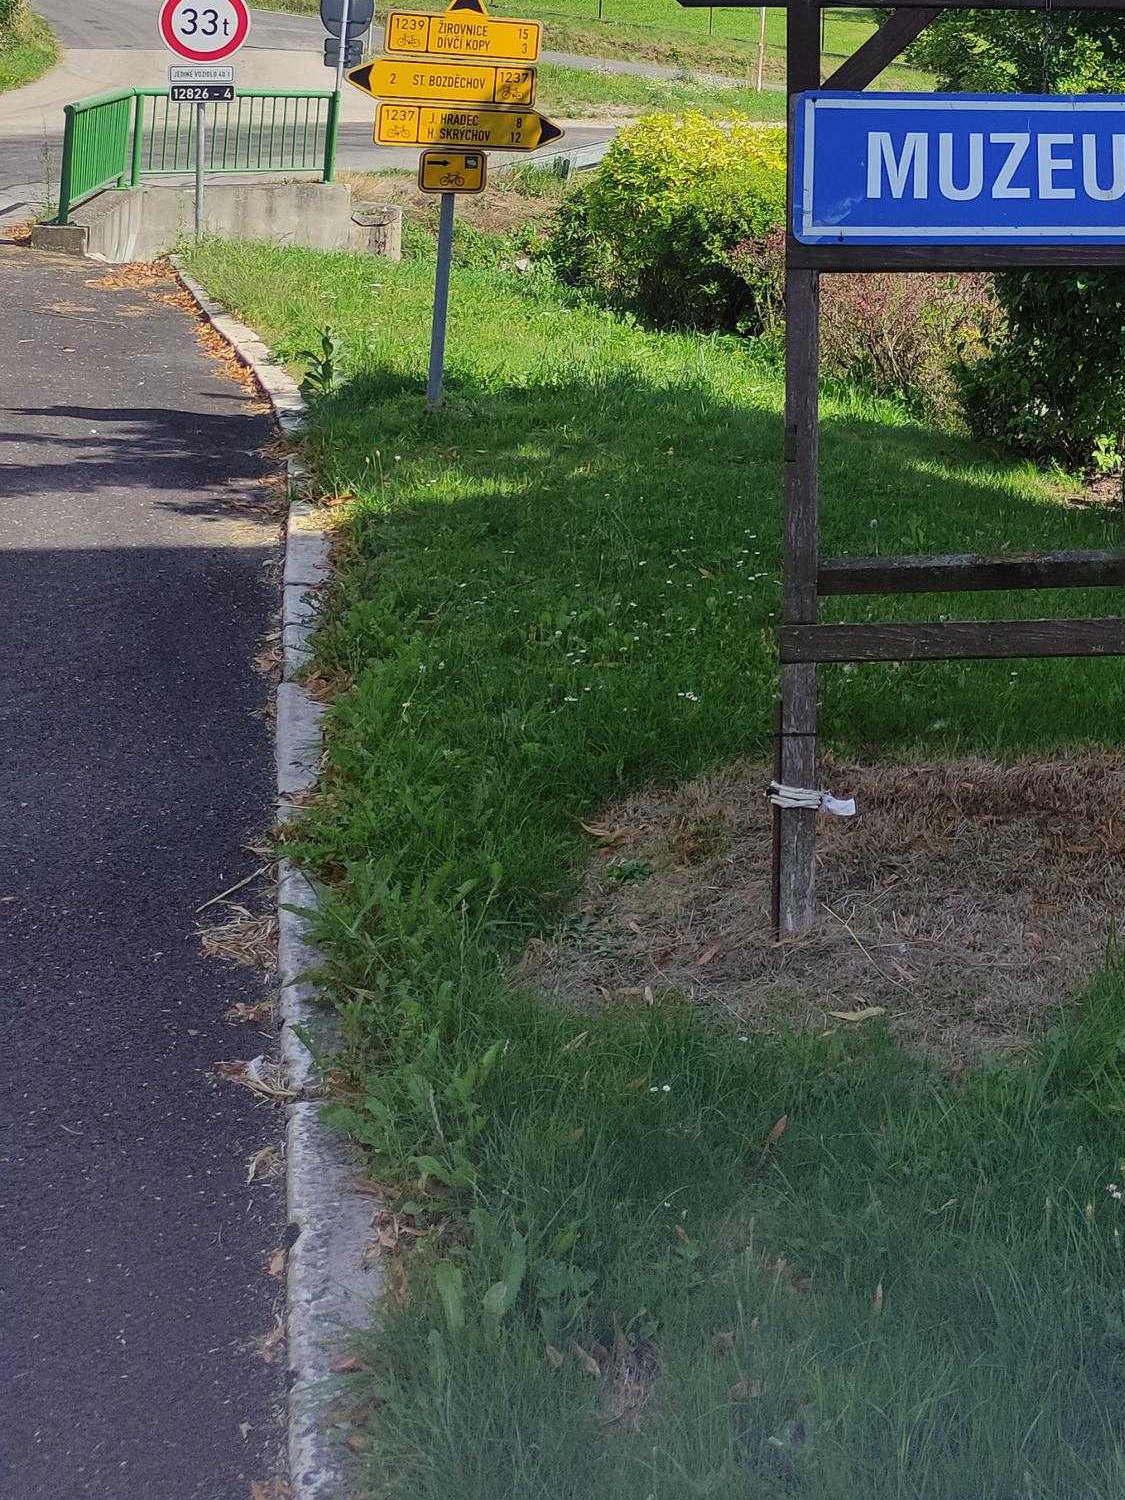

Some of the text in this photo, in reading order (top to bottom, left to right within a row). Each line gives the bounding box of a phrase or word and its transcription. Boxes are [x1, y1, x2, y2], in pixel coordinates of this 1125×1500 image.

[395, 18, 425, 31] 1239
[438, 20, 529, 40] ŽIROVNICE 15
[437, 35, 528, 55] DÍVČÍ KOPY 3
[390, 73, 486, 90] 2 ST. BOZDĚCHOV
[500, 71, 529, 84] 1237
[173, 88, 209, 99] 12826
[223, 88, 231, 99] 4
[386, 109, 415, 121] 1237
[429, 113, 523, 129] J. HRADEC 8
[427, 127, 521, 143] H. SKRÝCHOV 12
